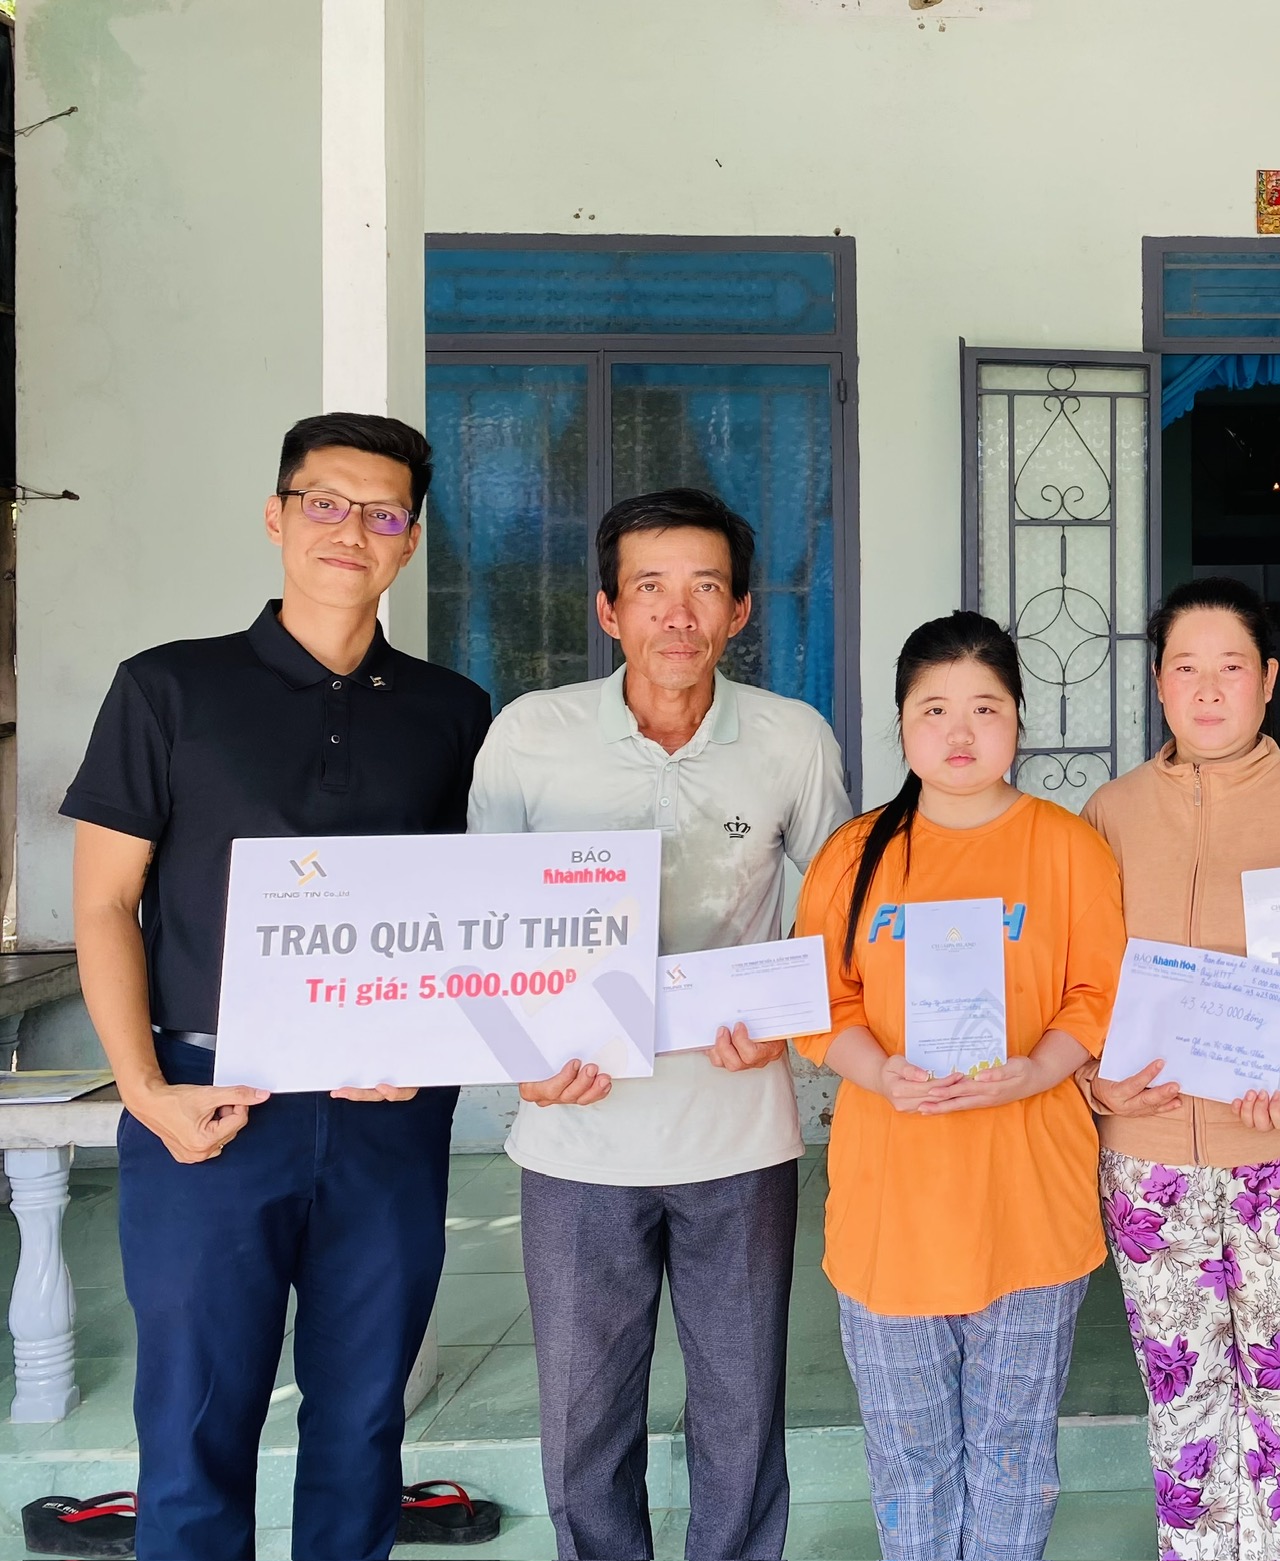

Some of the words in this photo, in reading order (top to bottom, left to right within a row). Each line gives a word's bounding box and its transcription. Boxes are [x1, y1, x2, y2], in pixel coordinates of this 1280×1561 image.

[571, 846, 612, 864] BÁO
[263, 891, 301, 899] TRUNG
[302, 891, 321, 899] TIN
[256, 922, 358, 957] TRAO
[370, 912, 445, 958] QUÀ
[457, 910, 510, 952] TỪ
[519, 907, 629, 954] THIỆN
[305, 977, 347, 1009] Trị
[355, 975, 408, 1006] giá:
